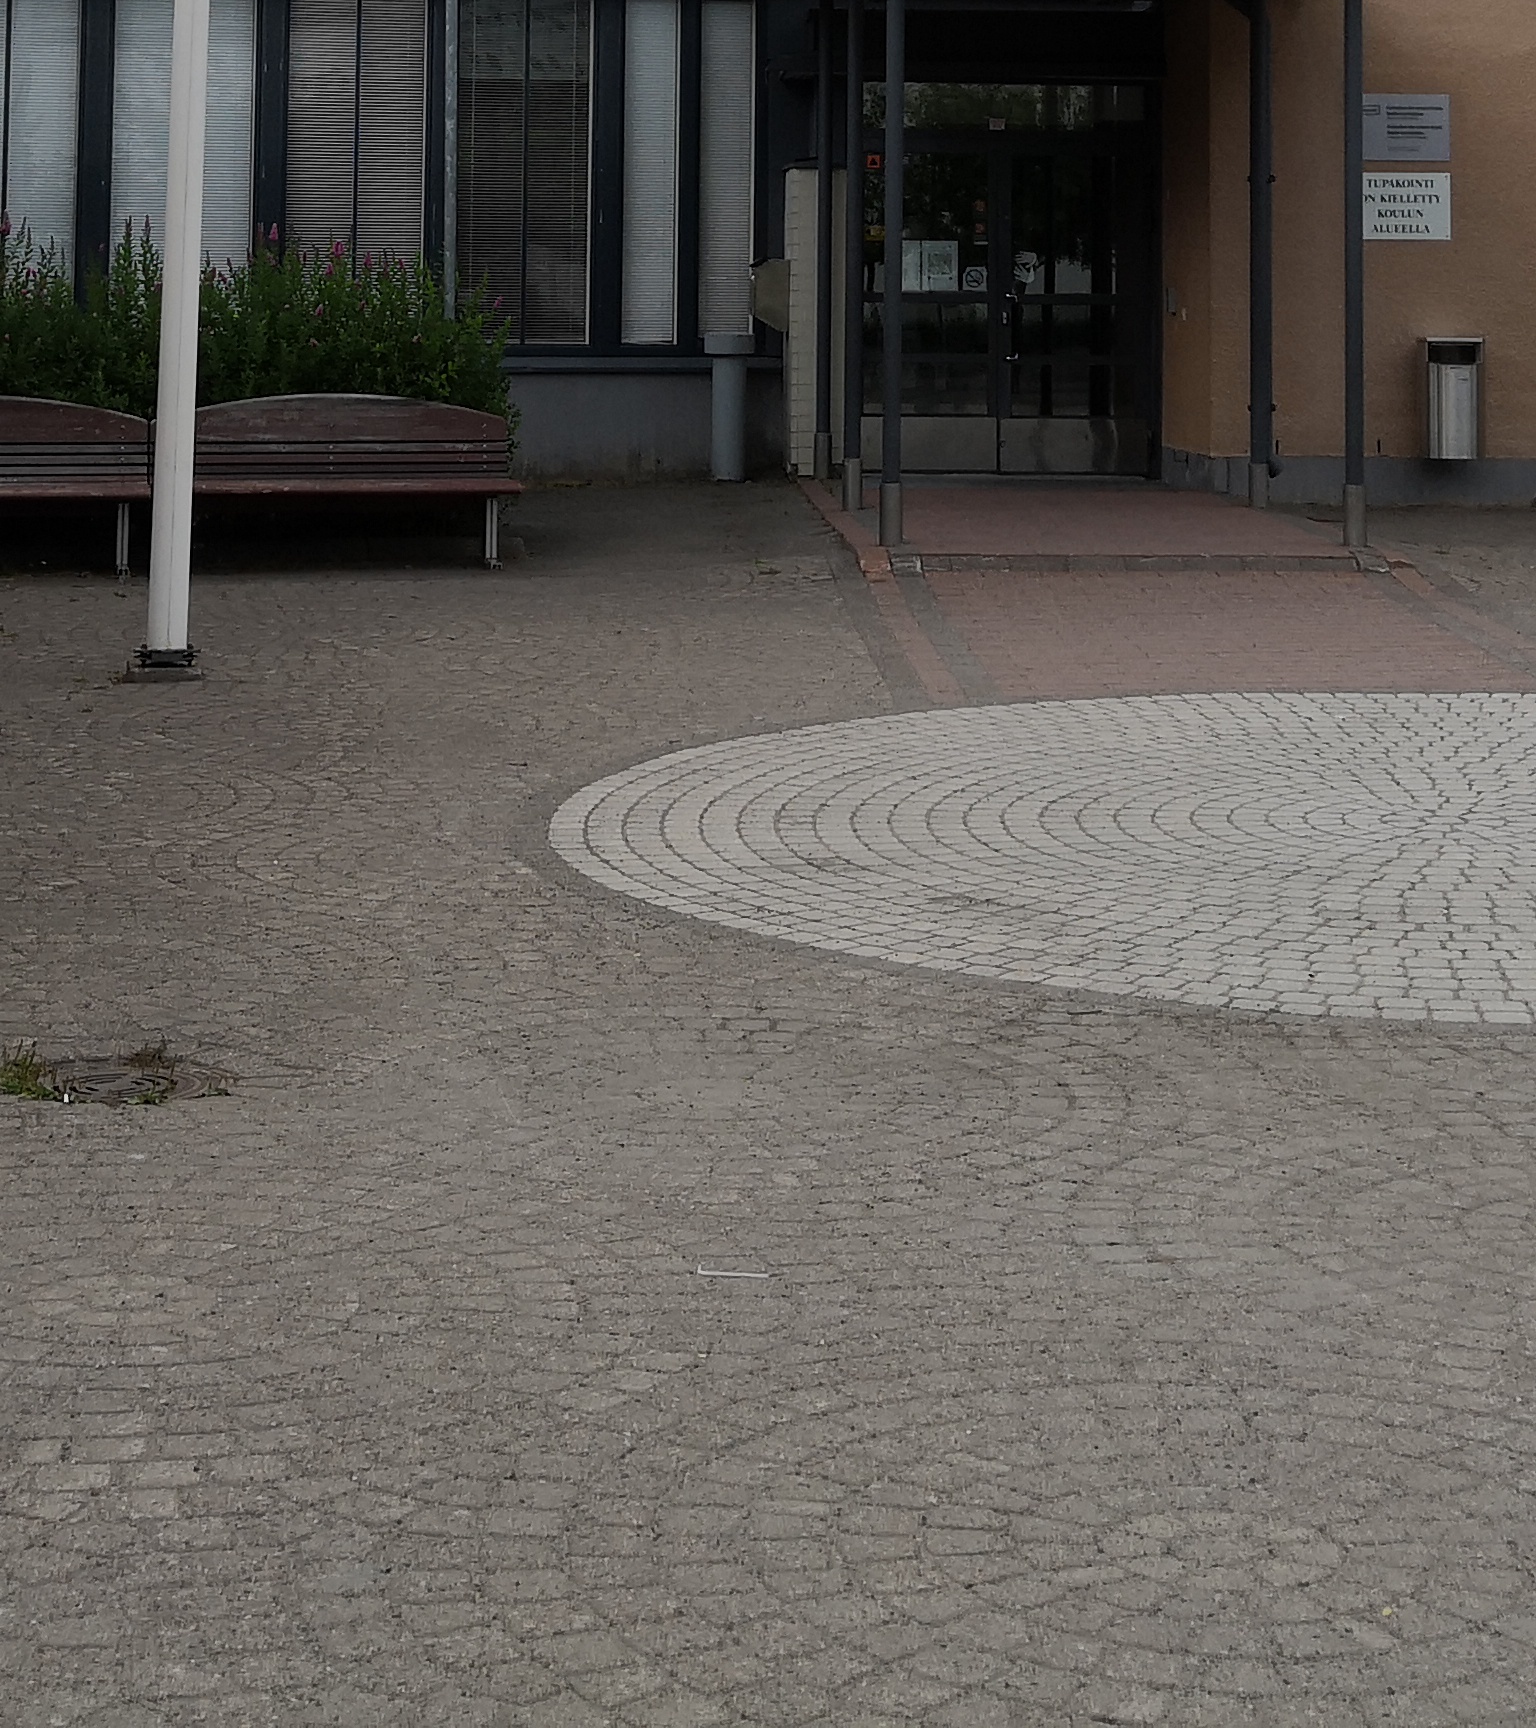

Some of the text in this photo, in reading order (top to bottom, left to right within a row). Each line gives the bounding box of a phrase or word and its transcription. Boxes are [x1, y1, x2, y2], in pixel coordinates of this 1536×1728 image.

[1367, 179, 1434, 188] TUPAKOINTI
[1380, 194, 1440, 203] KIELLETTY
[1377, 209, 1424, 218] KOULUN
[1372, 224, 1430, 233] ALUEELLA
